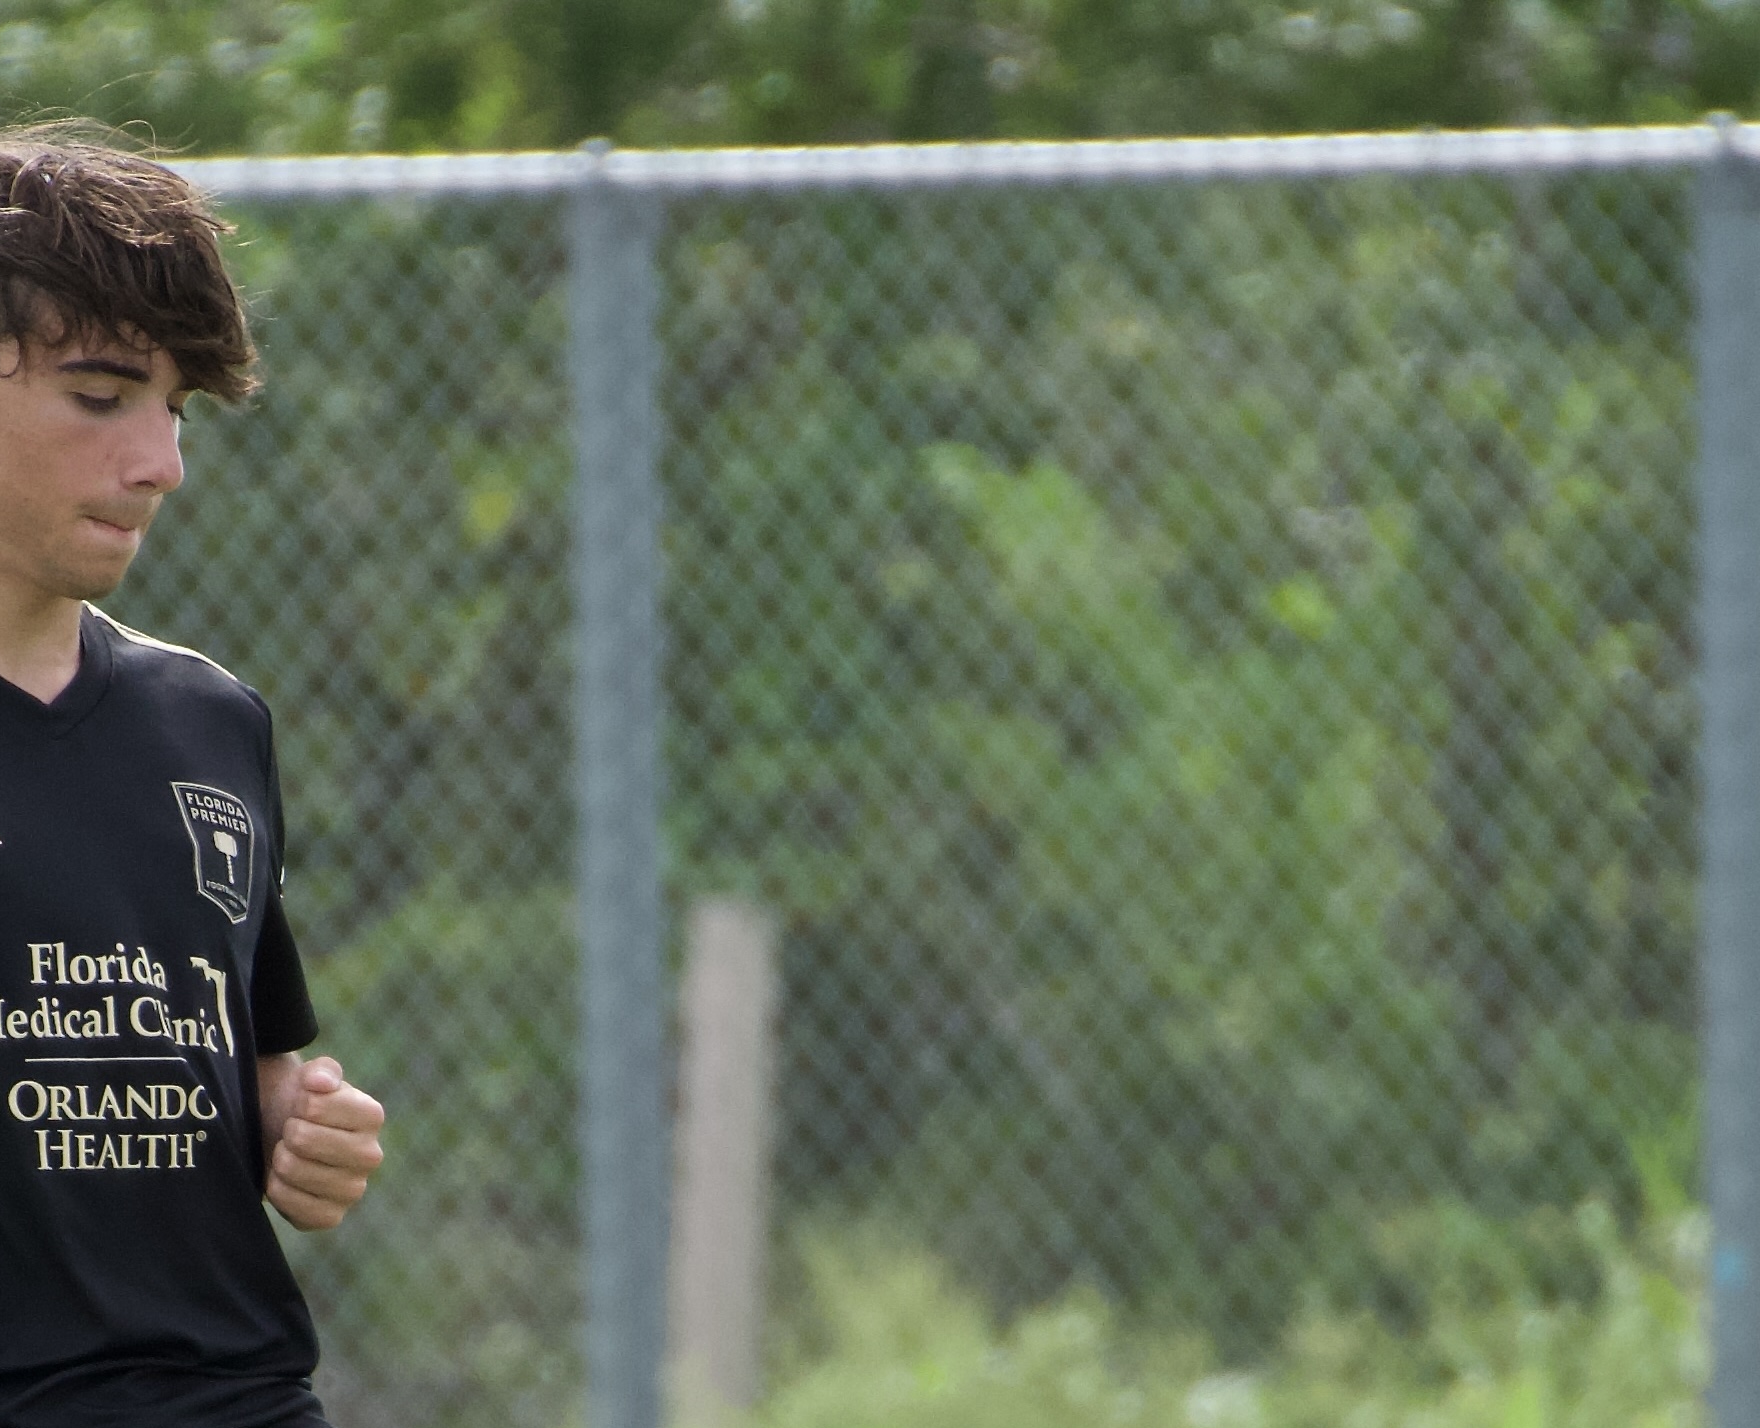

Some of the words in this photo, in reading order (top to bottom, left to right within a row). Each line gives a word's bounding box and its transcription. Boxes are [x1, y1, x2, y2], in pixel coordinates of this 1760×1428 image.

[185, 792, 245, 819] FLORIDA
[190, 807, 249, 835] PREMIER
[26, 942, 168, 992] Florida
[129, 996, 219, 1054] Clinic
[7, 1080, 218, 1121] ORLANDO
